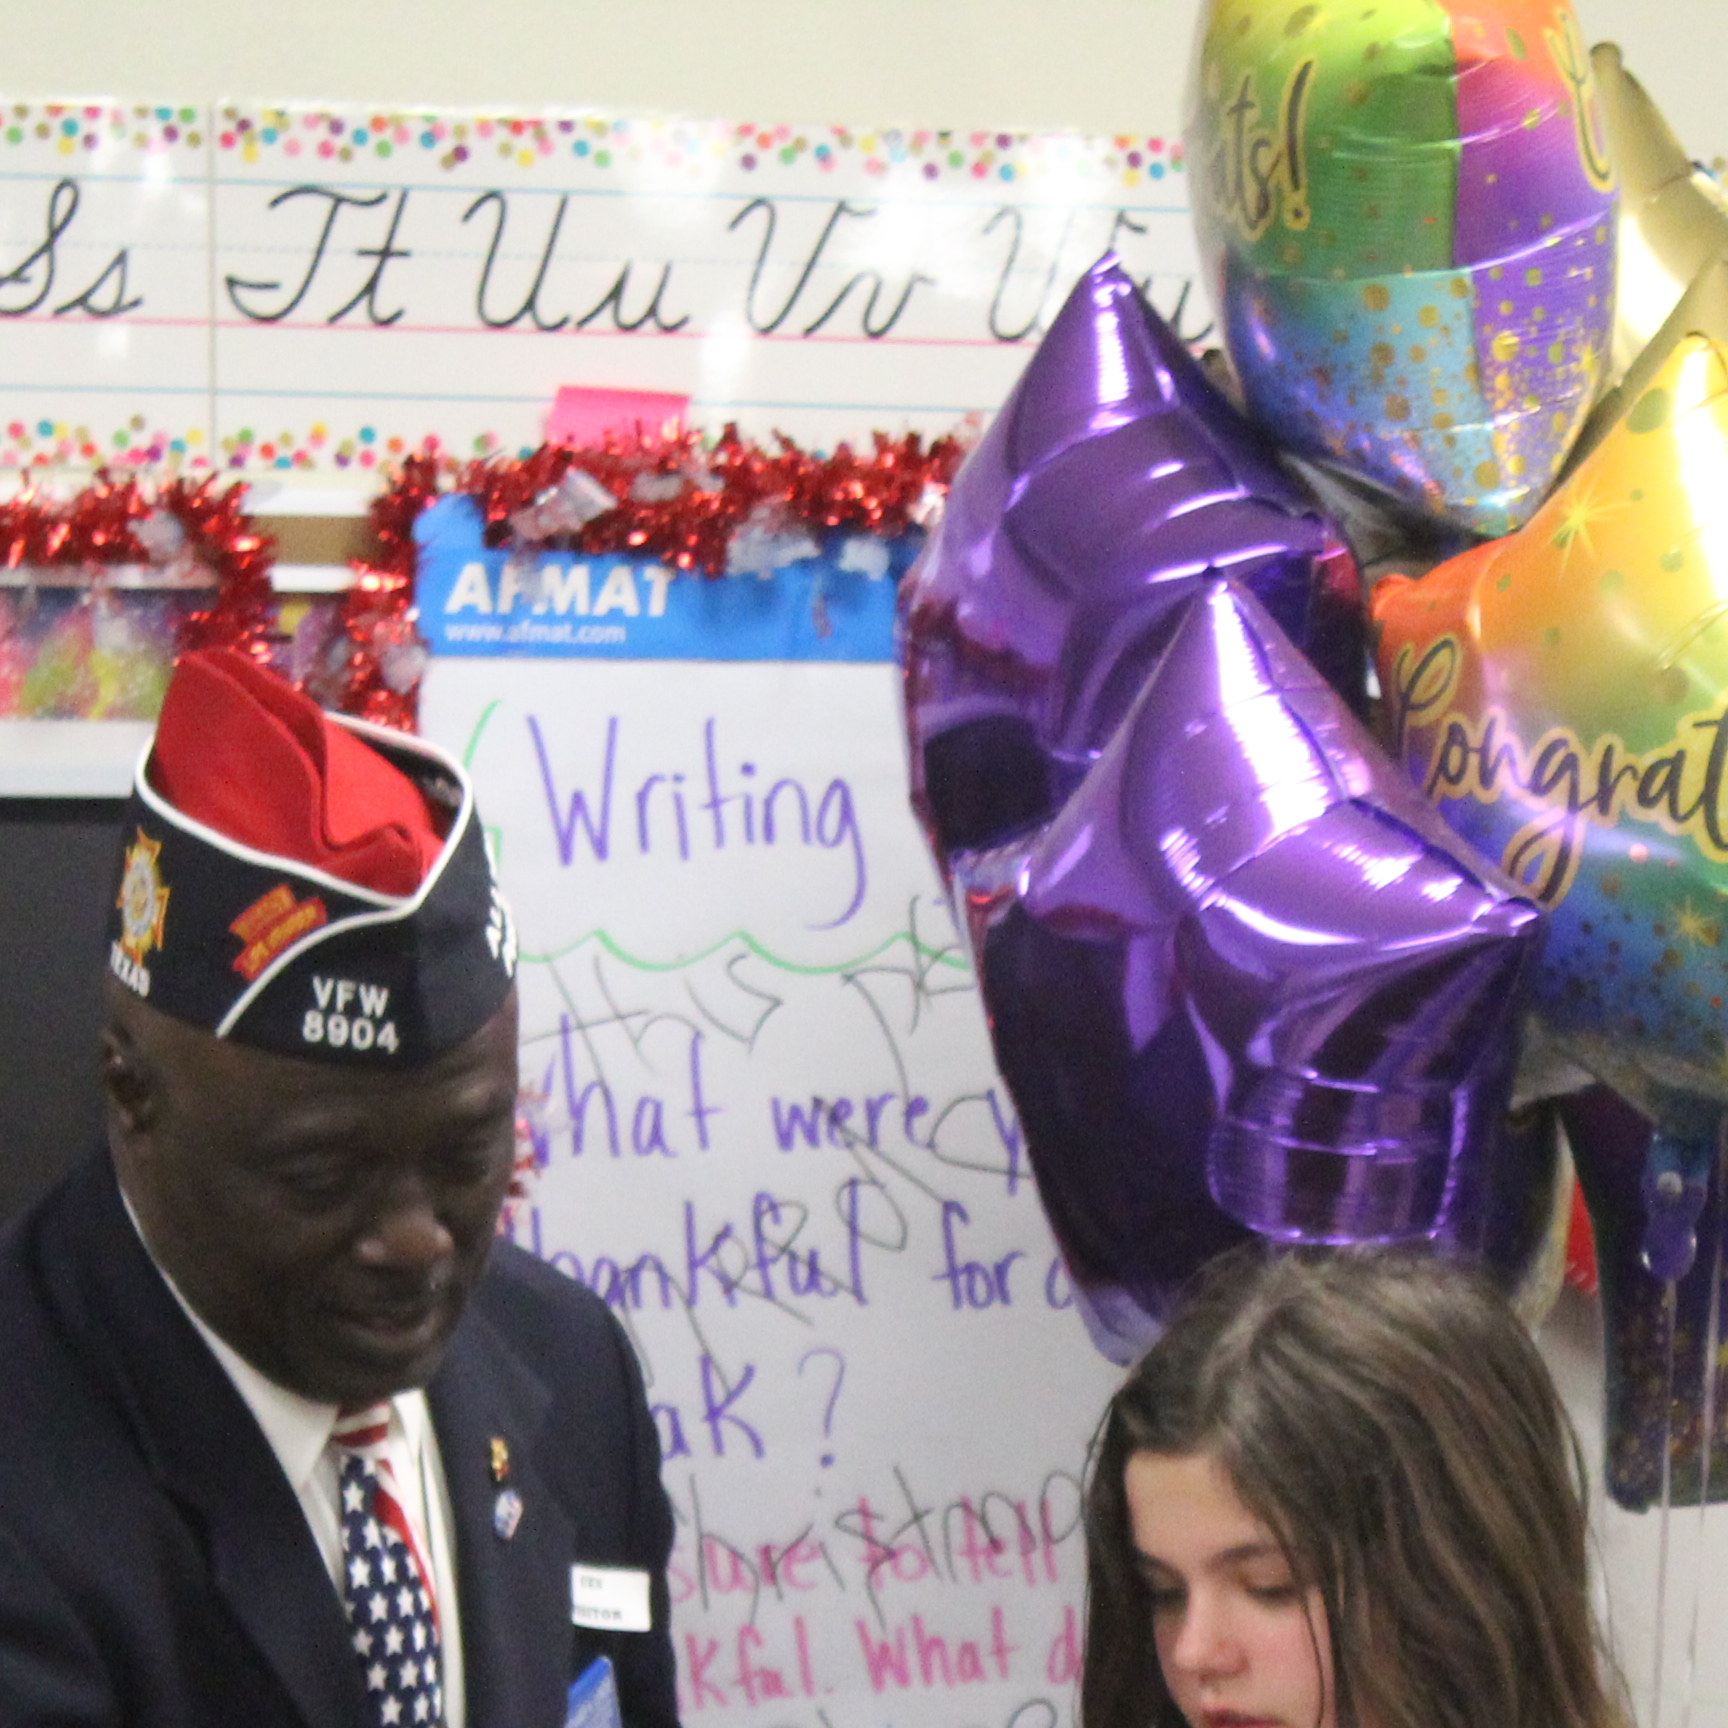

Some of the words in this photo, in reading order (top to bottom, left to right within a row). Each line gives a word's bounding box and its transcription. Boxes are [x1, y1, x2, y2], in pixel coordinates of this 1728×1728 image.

[445, 620, 626, 643] www.afmat.com
[528, 714, 868, 930] Writing
[302, 1010, 400, 1053] 8904
[312, 976, 388, 1018] VFW
[770, 1083, 932, 1154] were
[502, 1175, 870, 1310] hankful
[932, 1200, 1028, 1310] for
[852, 1604, 1022, 1694] What
